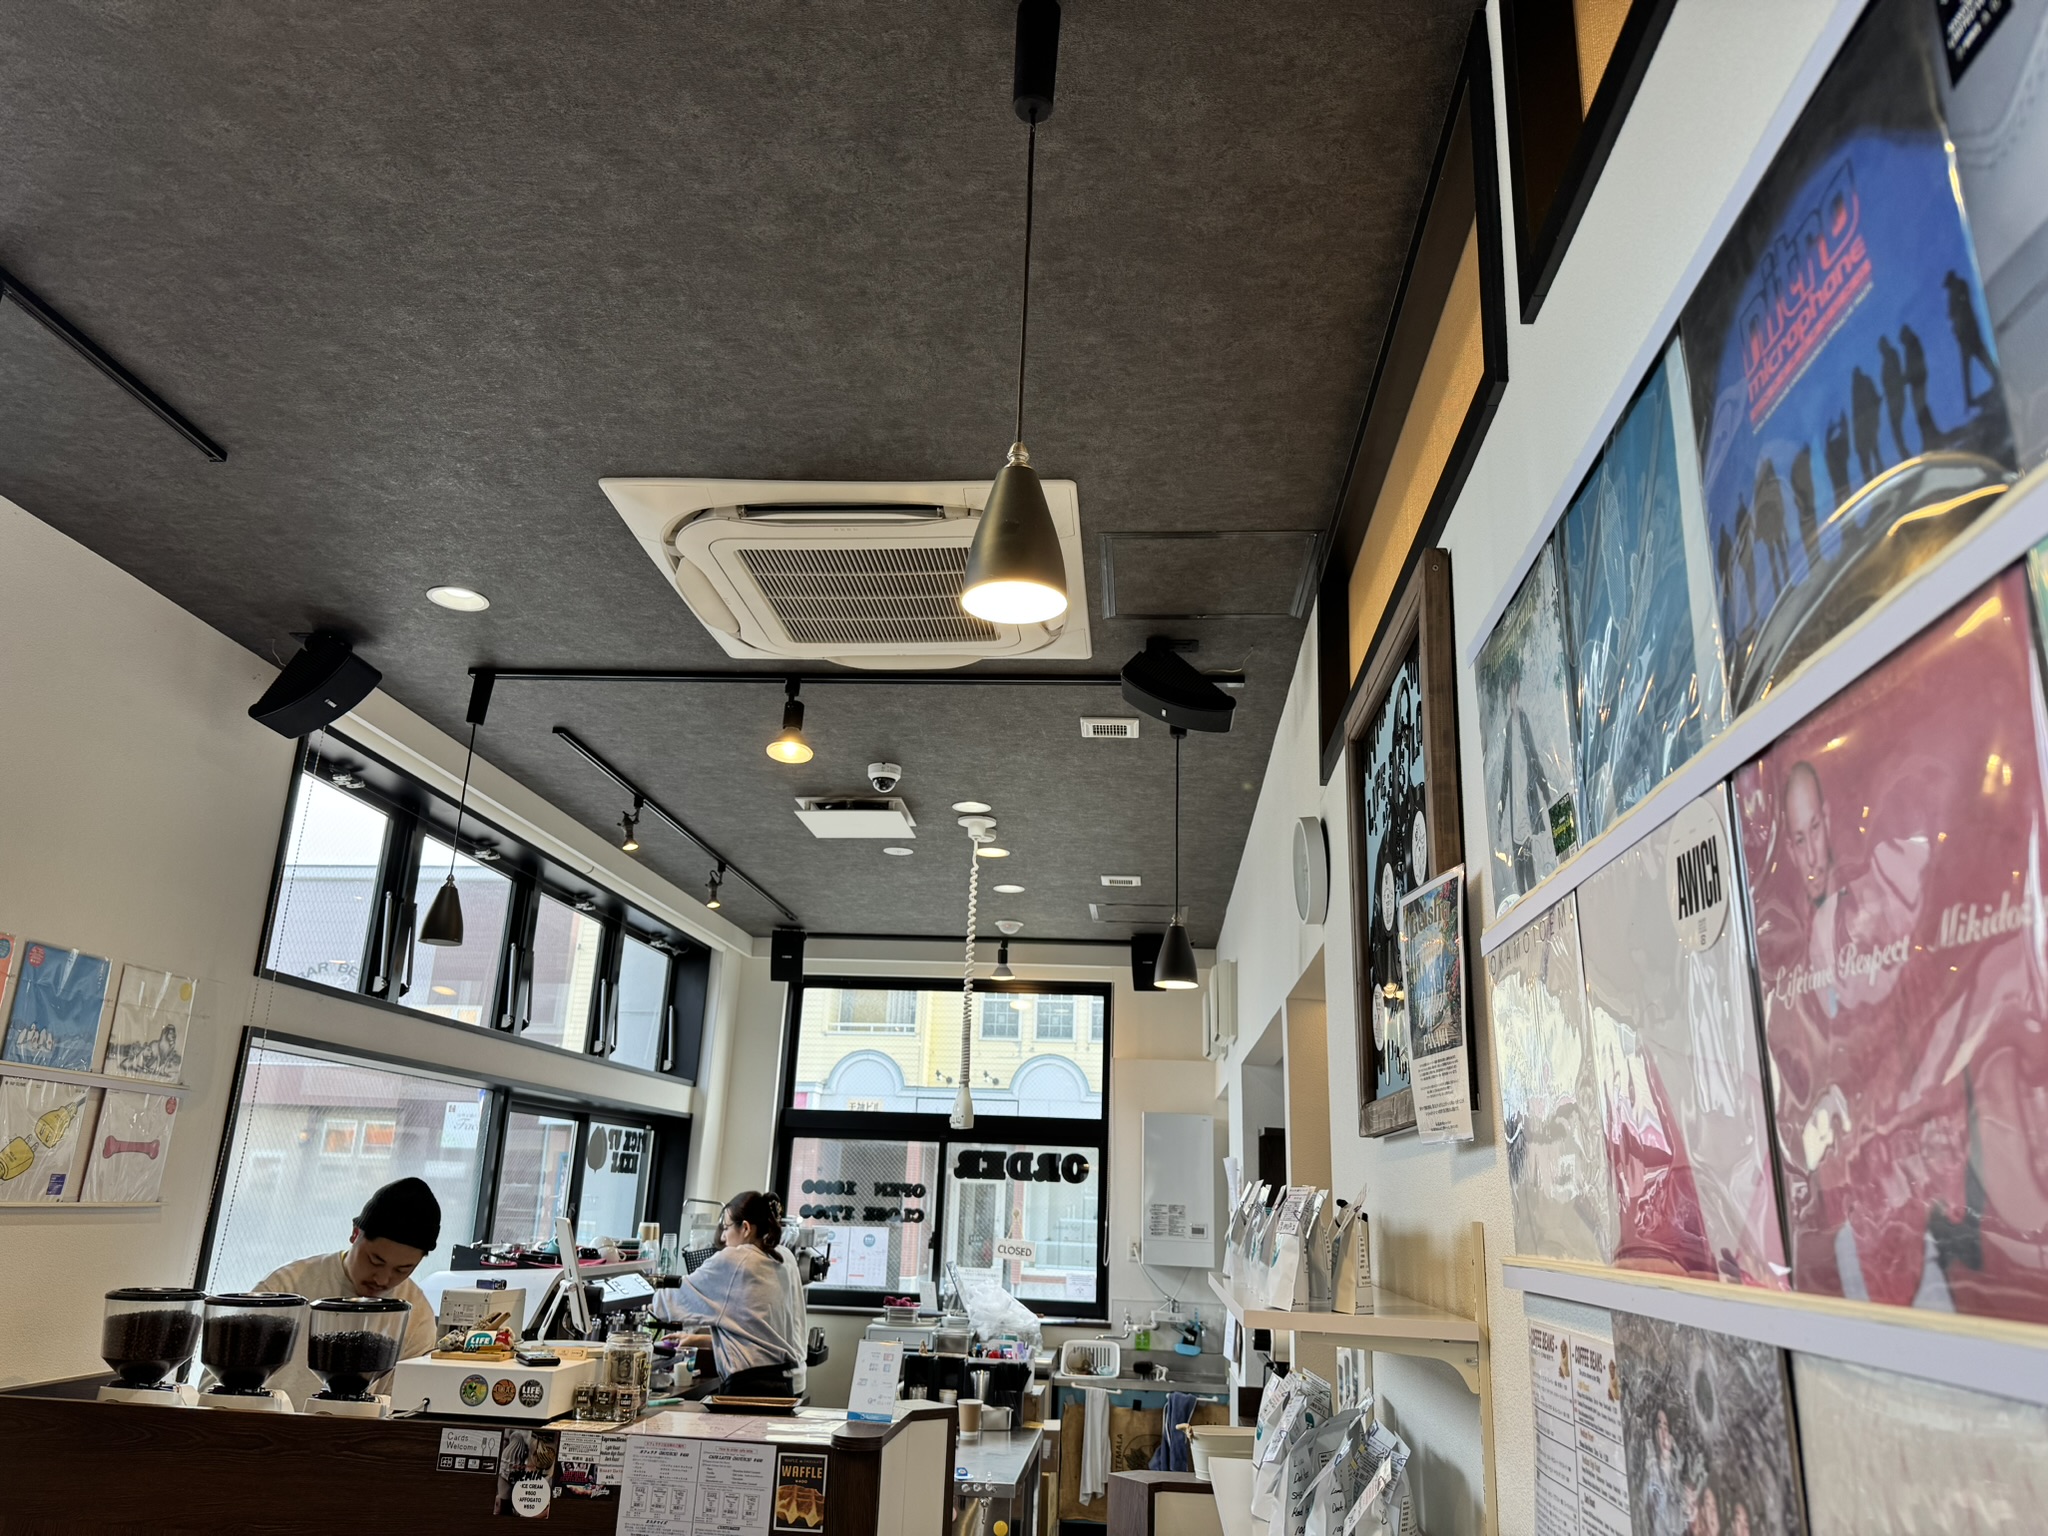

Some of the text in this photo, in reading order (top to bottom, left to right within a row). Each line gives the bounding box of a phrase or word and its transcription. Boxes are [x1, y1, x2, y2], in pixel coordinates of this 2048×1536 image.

[1676, 834, 1722, 921] AWICH
[1835, 934, 1911, 987] Respect
[997, 1244, 1033, 1258] CLOSED
[470, 1326, 491, 1336] LIFE
[521, 1385, 541, 1395] LIFE
[447, 1431, 469, 1442] Cards
[446, 1441, 478, 1452] Welcome
[781, 1465, 823, 1479] WAFFLE
